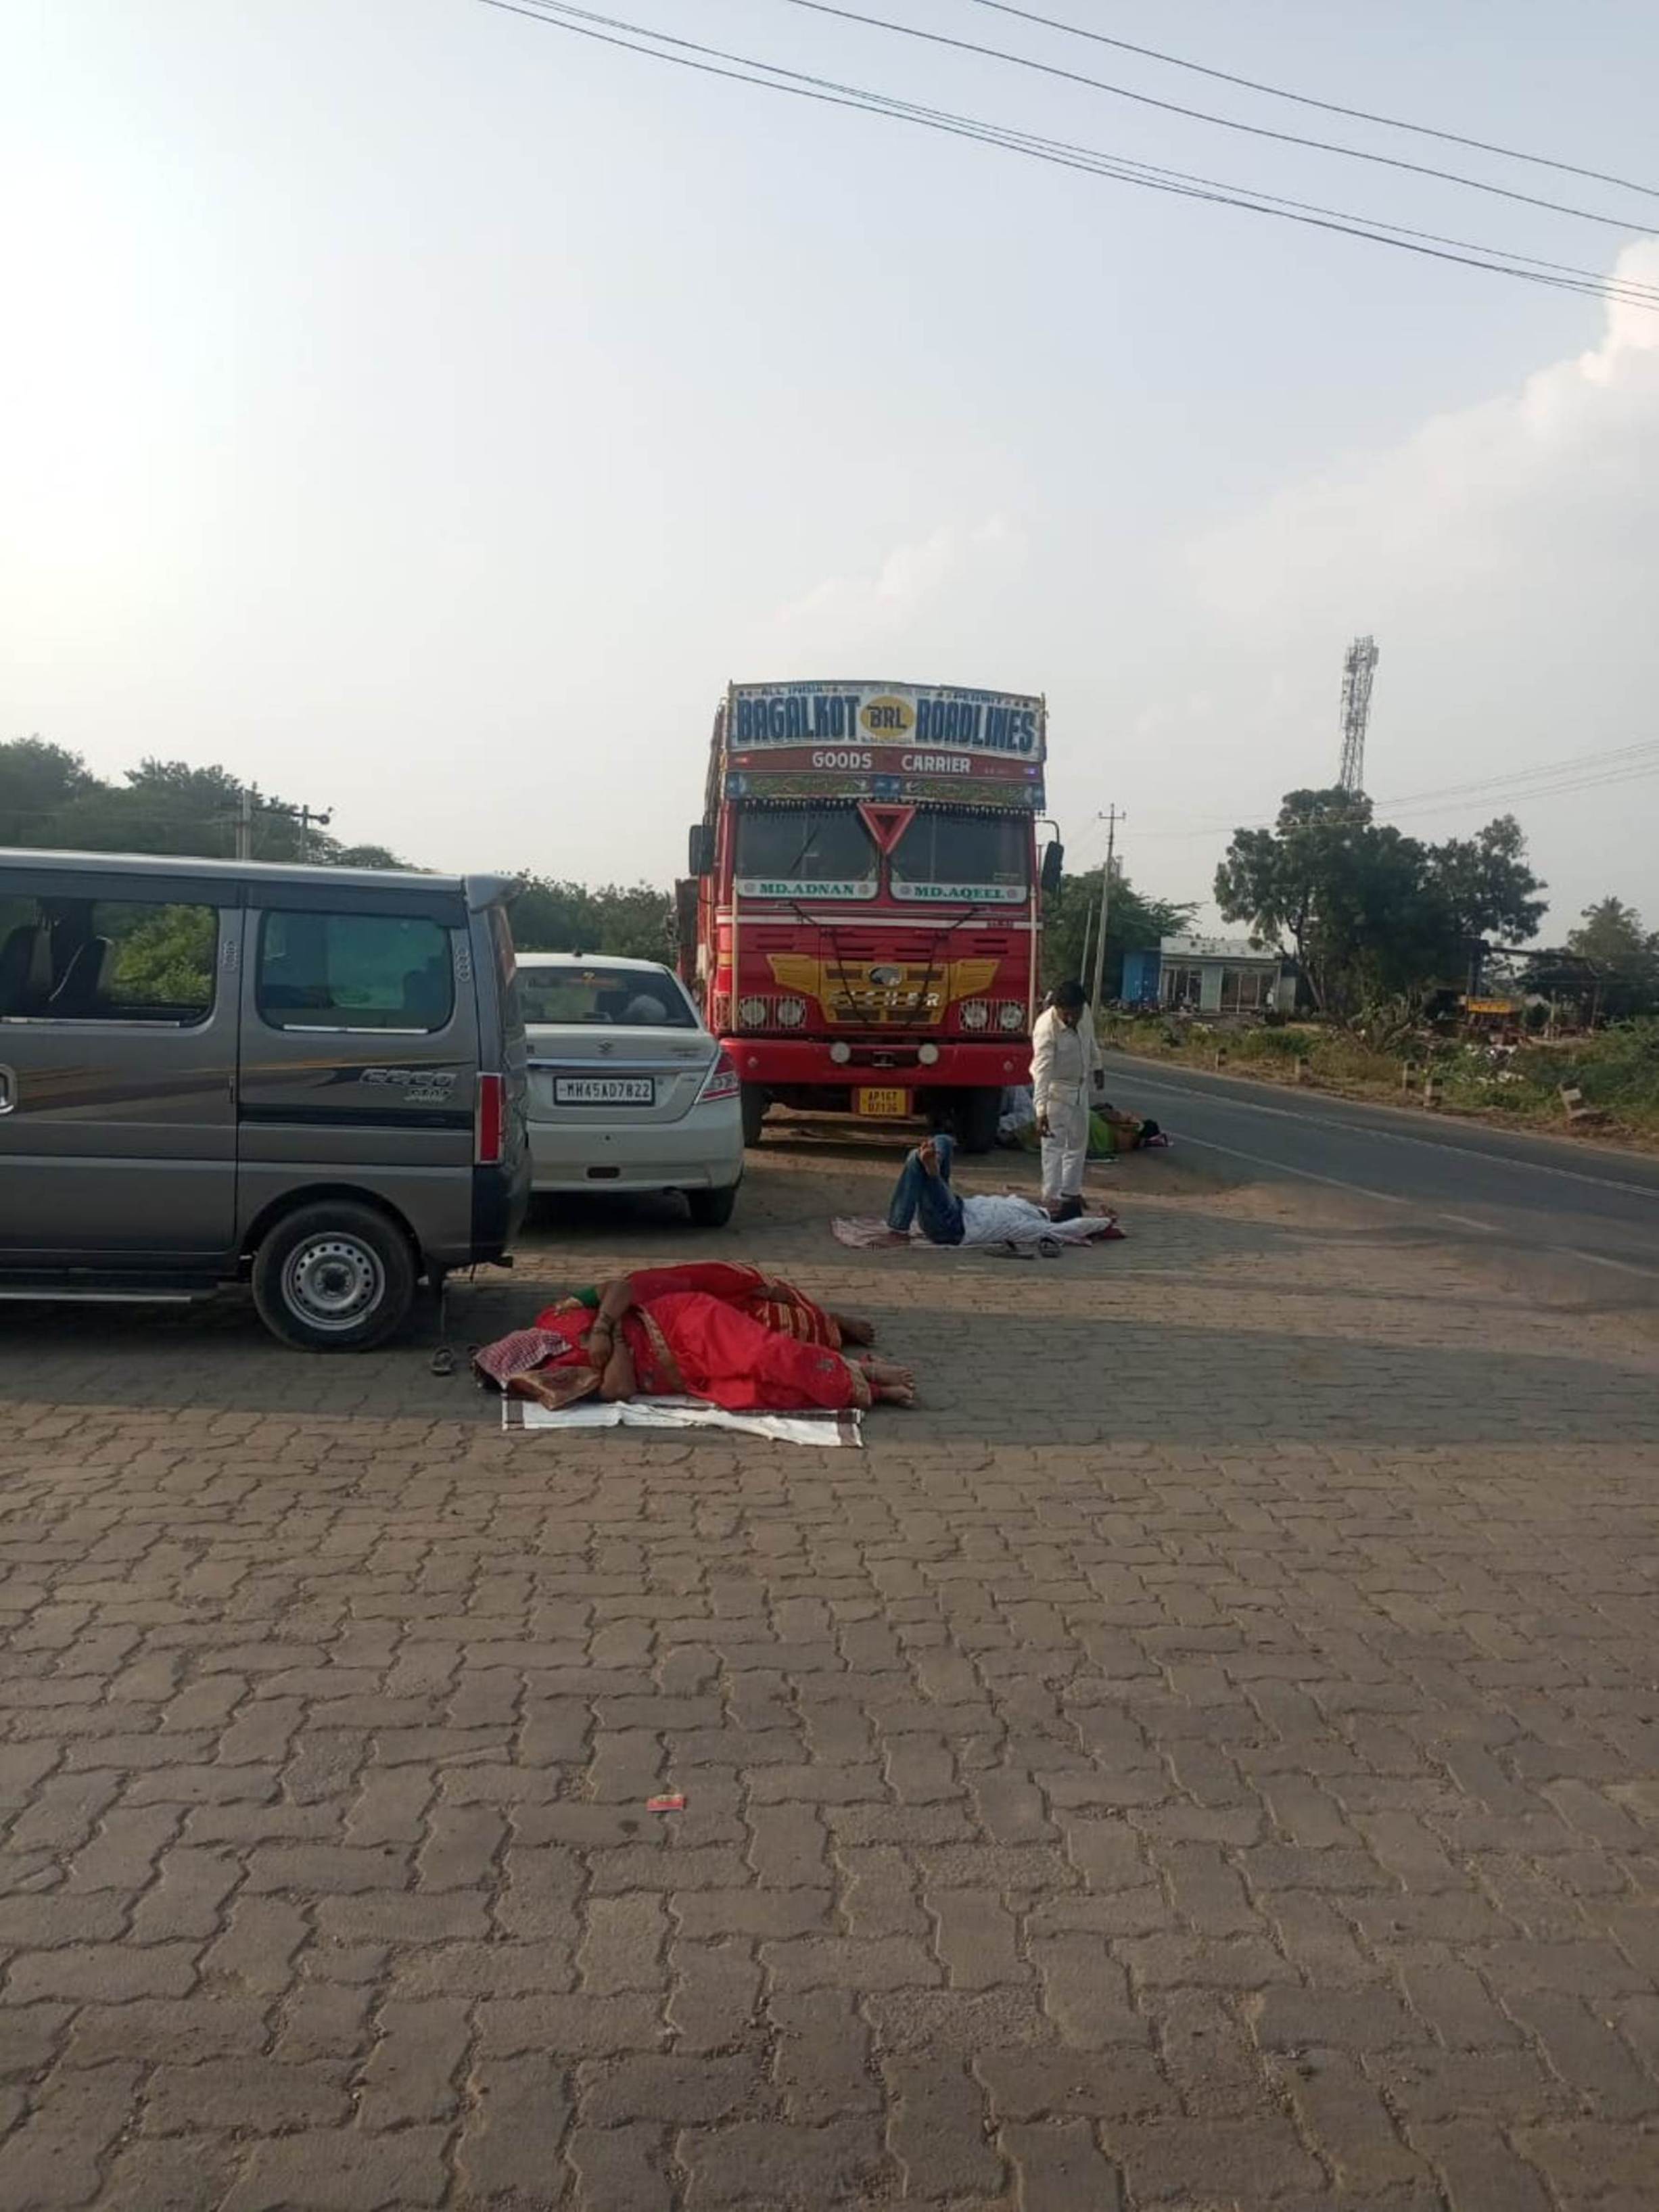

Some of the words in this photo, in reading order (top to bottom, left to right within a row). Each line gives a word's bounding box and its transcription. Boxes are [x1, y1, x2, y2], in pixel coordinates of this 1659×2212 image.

[737, 695, 860, 742] BAGALKOT
[866, 705, 908, 729] BRL
[915, 699, 1036, 753] ROADLINES
[812, 751, 872, 770] GOODS
[901, 755, 971, 774] CARRIER
[760, 883, 855, 895] MD.ADNAN
